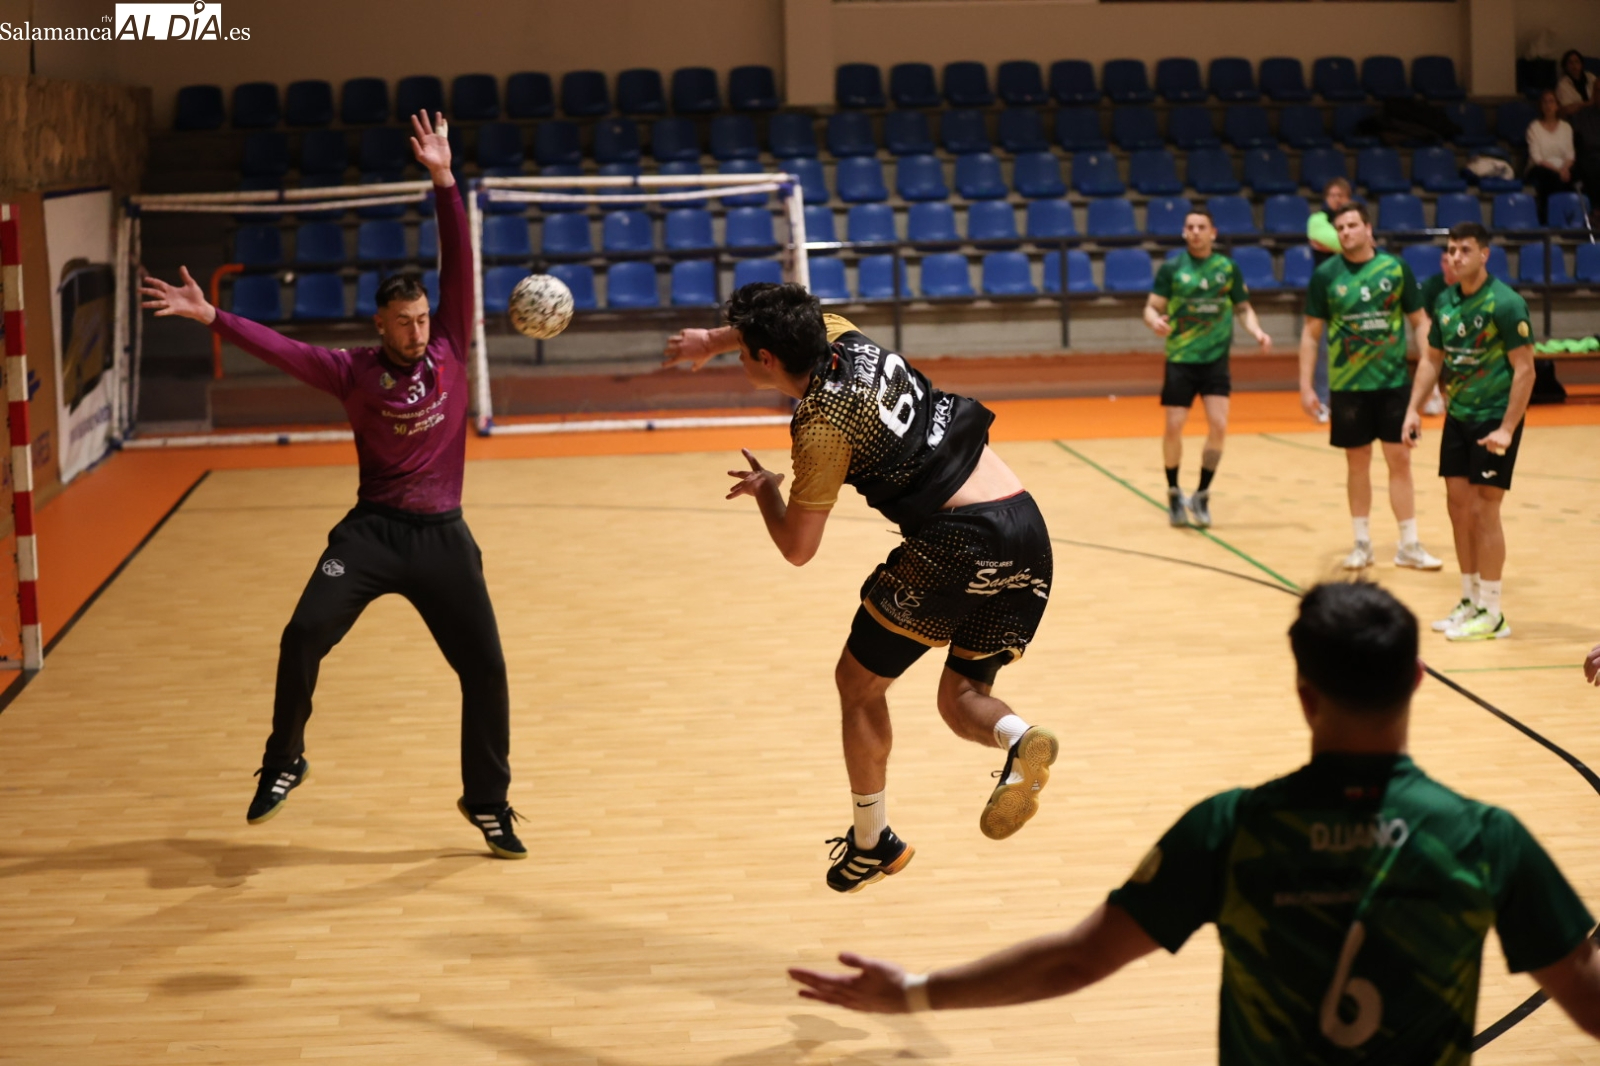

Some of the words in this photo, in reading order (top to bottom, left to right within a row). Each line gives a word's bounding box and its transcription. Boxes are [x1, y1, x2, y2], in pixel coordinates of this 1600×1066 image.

[1360, 286, 1372, 302] 5
[393, 423, 407, 435] 50
[1319, 920, 1384, 1047] 6
